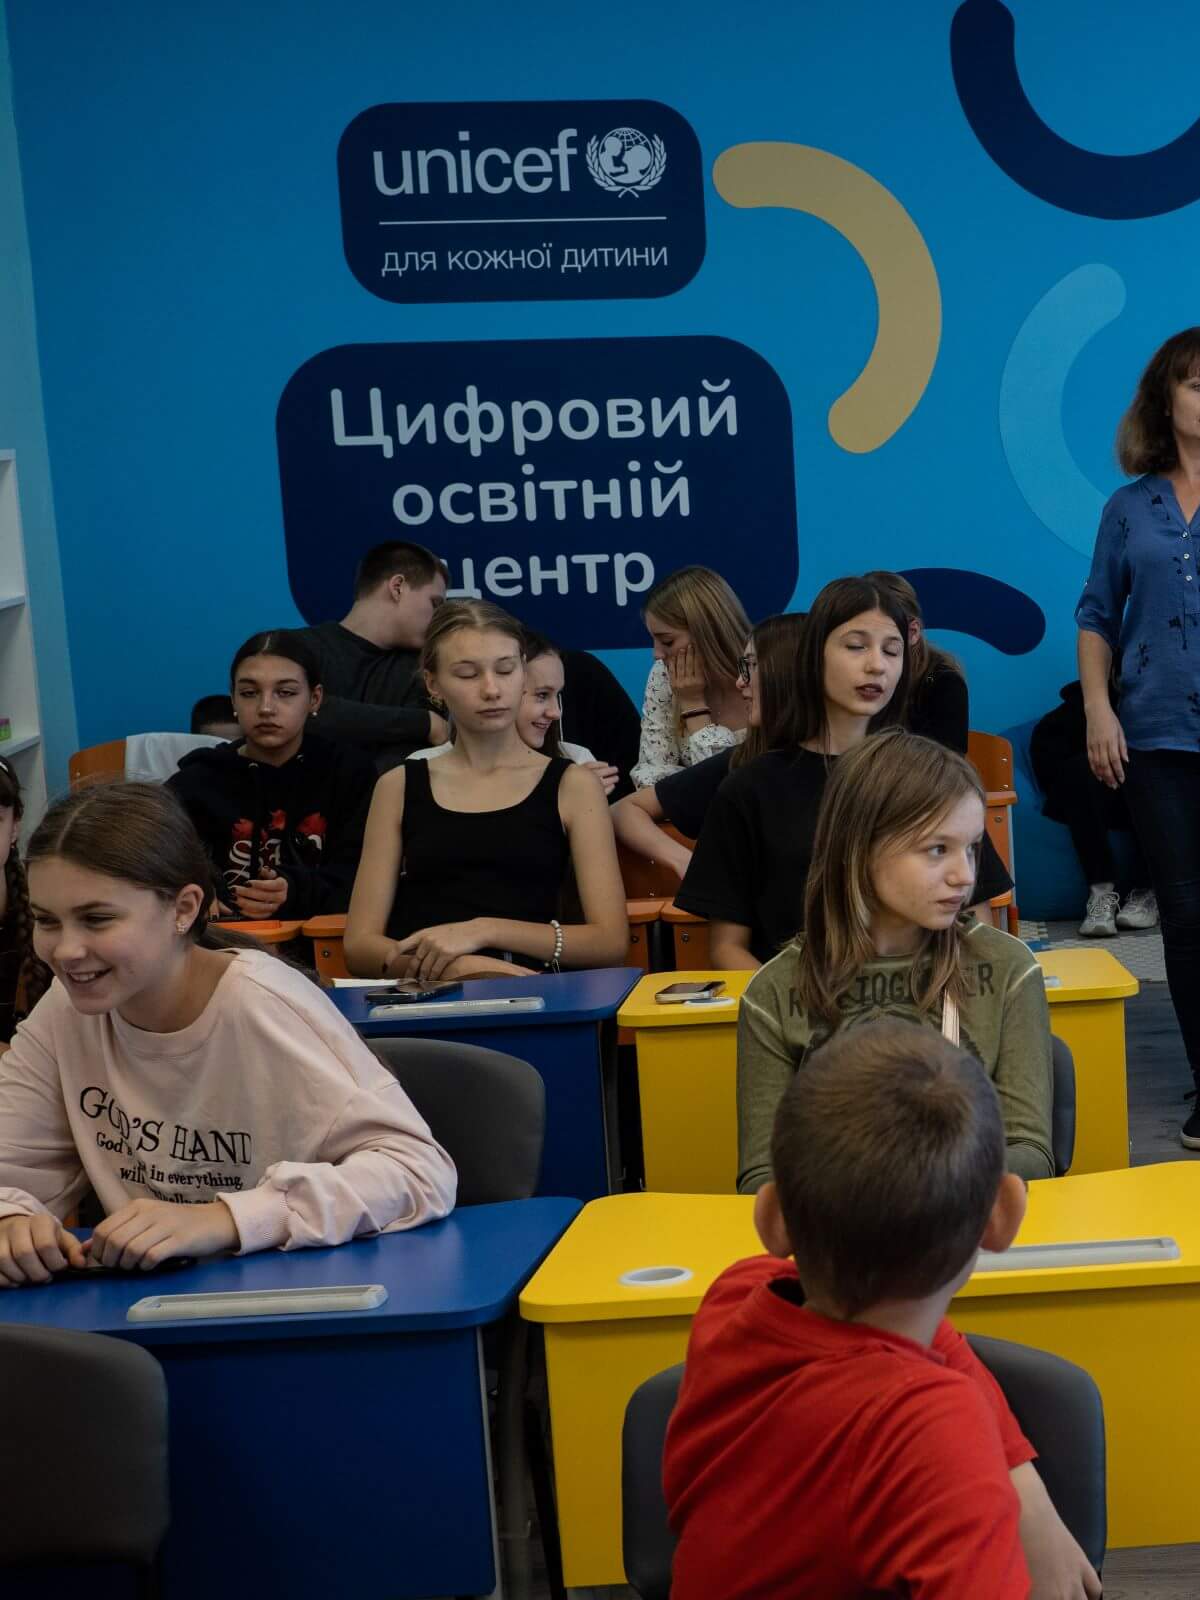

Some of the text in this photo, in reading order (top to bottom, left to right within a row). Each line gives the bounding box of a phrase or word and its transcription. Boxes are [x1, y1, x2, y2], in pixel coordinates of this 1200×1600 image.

[373, 128, 578, 196] unicef
[381, 242, 669, 277] для кожної дитини
[330, 378, 738, 458] Цифровий
[392, 460, 690, 525] освітній
